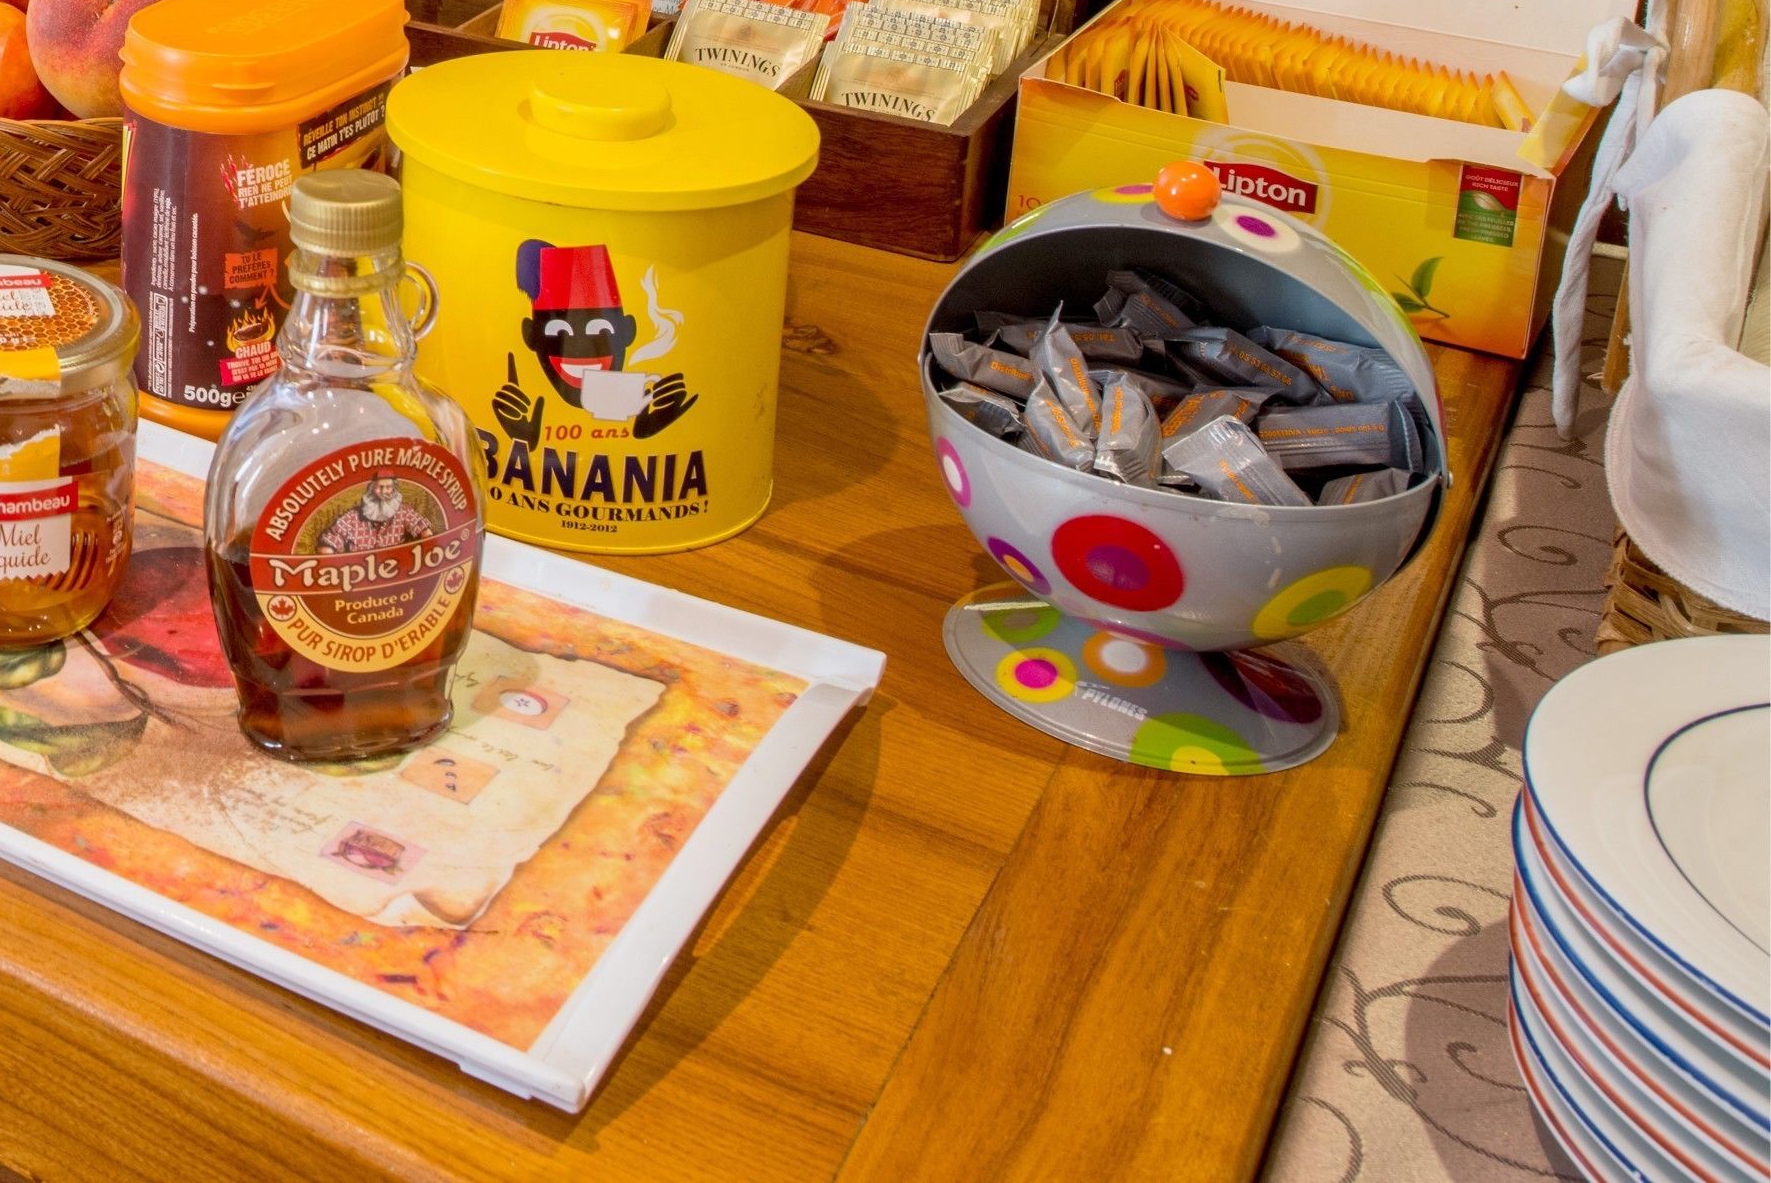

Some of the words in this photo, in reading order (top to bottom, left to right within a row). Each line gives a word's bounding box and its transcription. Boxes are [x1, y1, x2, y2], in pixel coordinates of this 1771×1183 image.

[695, 47, 780, 77] TWININGS
[841, 91, 937, 122] TWININGS
[307, 146, 316, 160] CE
[317, 133, 338, 154] MATIN
[237, 159, 290, 187] FÉROCE
[1484, 177, 1519, 186] DÉLICIEUX
[238, 185, 259, 198] RIEN
[261, 182, 272, 193] NE
[275, 175, 292, 190] PEUT
[239, 185, 293, 209] T'ATTEINDR
[1213, 167, 1307, 208] Lipton
[1490, 183, 1508, 191] TASTE
[241, 254, 251, 264] TU
[252, 252, 262, 261] LE
[229, 271, 268, 284] COMMENT
[235, 342, 271, 358] CHAUD
[545, 425, 582, 442] 100
[591, 426, 629, 440] ans
[475, 427, 709, 503] BANANIA
[266, 460, 346, 542] ABSOLUTELY
[348, 447, 394, 472] PURE
[396, 447, 445, 480] MAPLE
[438, 468, 468, 511] SYRUP
[506, 492, 550, 514] ANS
[554, 501, 700, 523] GOURMANDS
[560, 520, 618, 534] 1912-2012
[269, 554, 399, 593] Maple
[408, 540, 461, 576] Joe
[334, 594, 398, 612] Produce
[400, 588, 415, 602] of
[347, 606, 404, 625] Canada
[287, 619, 325, 650] PUR
[322, 640, 376, 664] SIROP
[381, 596, 451, 660] D'ERABLE
